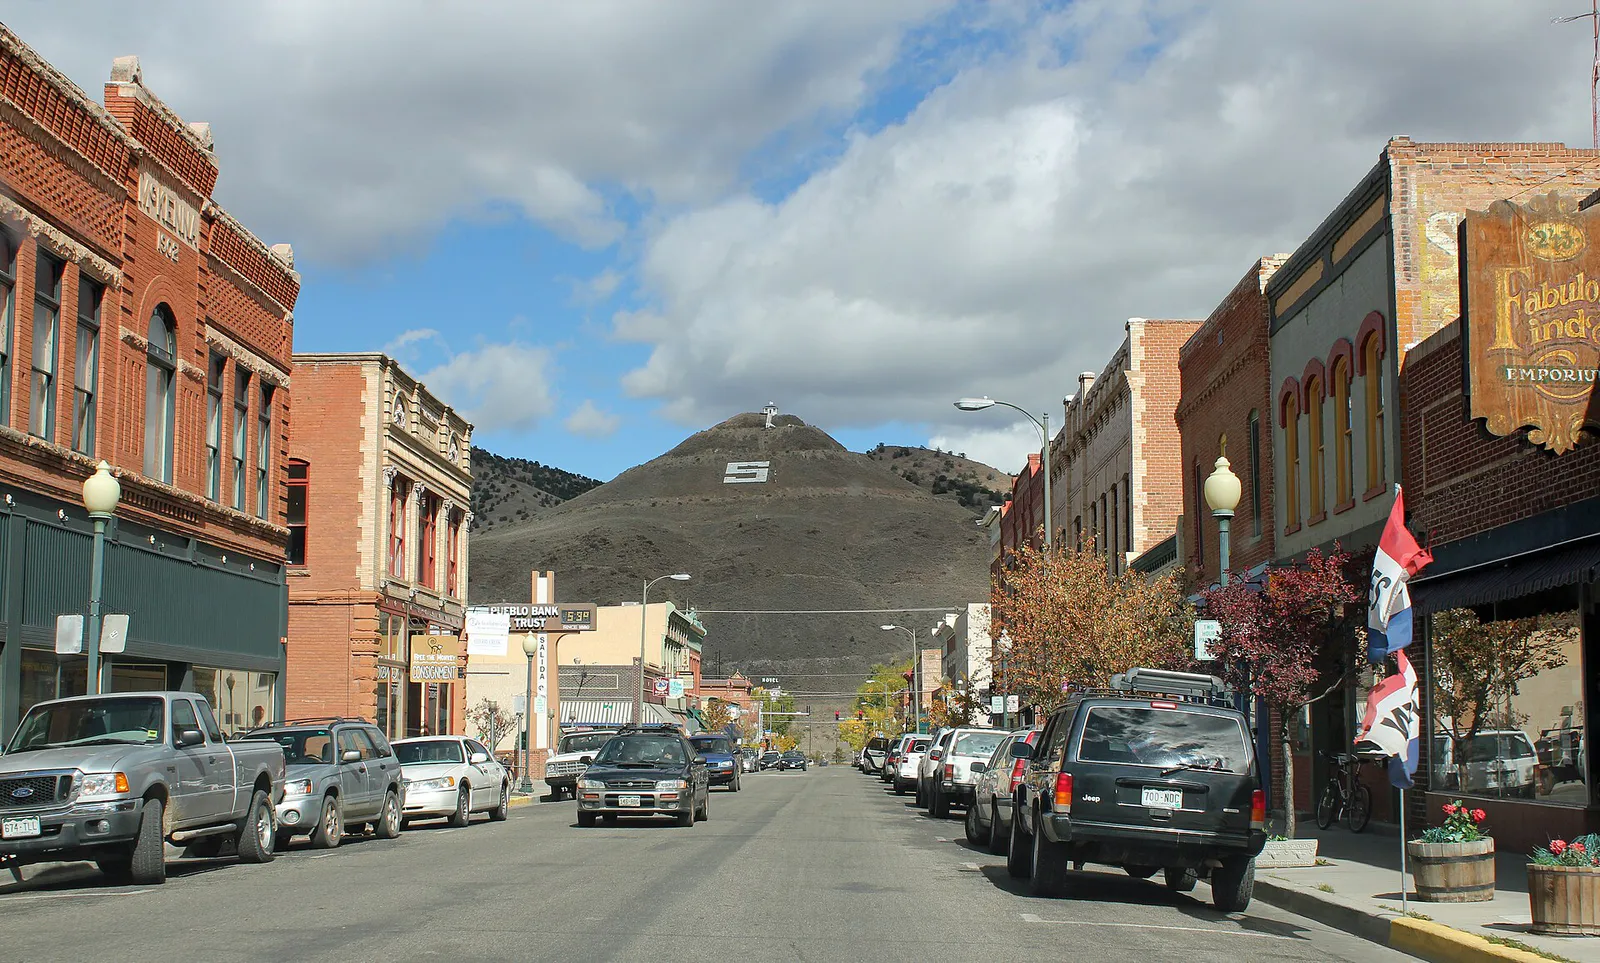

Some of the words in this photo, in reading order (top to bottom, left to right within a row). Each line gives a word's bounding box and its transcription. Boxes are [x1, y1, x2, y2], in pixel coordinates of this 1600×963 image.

[157, 228, 179, 262] 1902
[723, 461, 770, 484] S
[490, 606, 530, 617] PUEBLO
[531, 606, 559, 618] BANK
[514, 618, 547, 629] TRUST
[413, 665, 457, 680] CONSIGNMENT
[1082, 794, 1101, 804] Jeep
